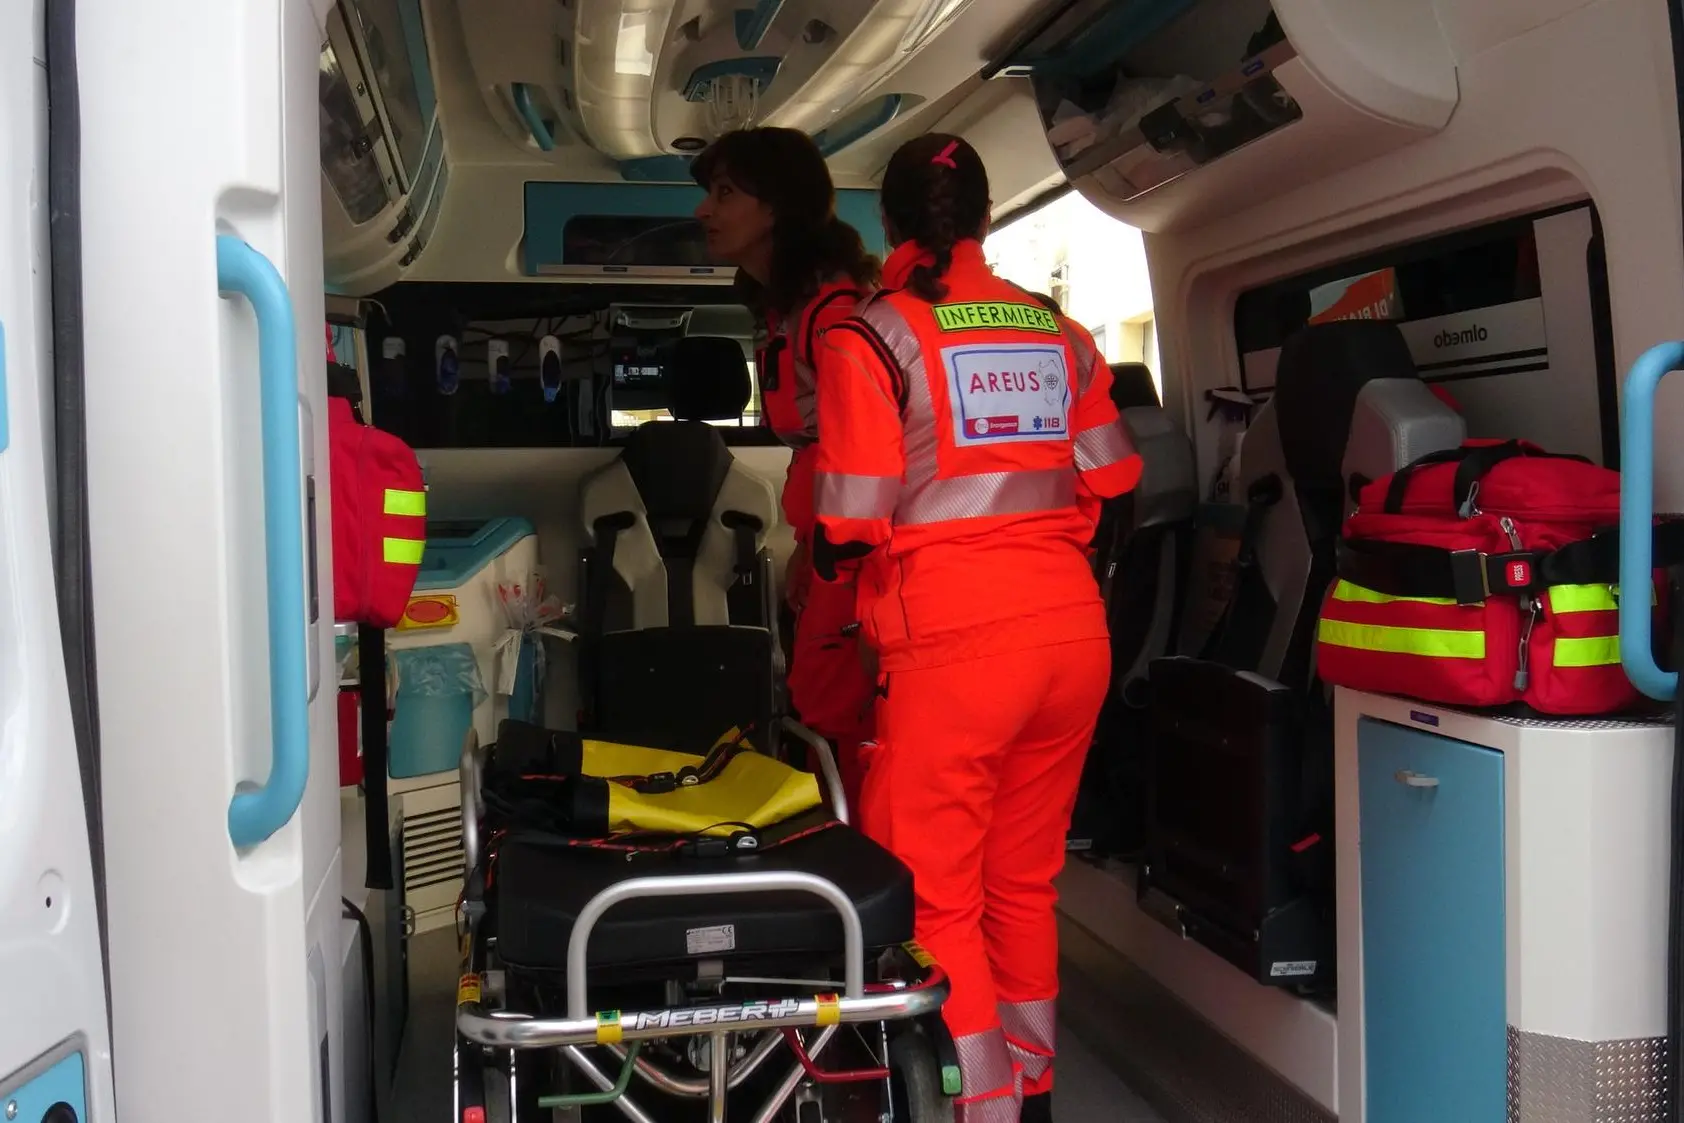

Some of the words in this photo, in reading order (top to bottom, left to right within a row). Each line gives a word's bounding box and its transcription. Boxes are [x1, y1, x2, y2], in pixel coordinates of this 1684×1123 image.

[941, 306, 1054, 329] INFERMIERE
[970, 371, 1040, 394] AREUS
[1044, 417, 1060, 429] 118
[636, 1005, 765, 1030] MEBER
